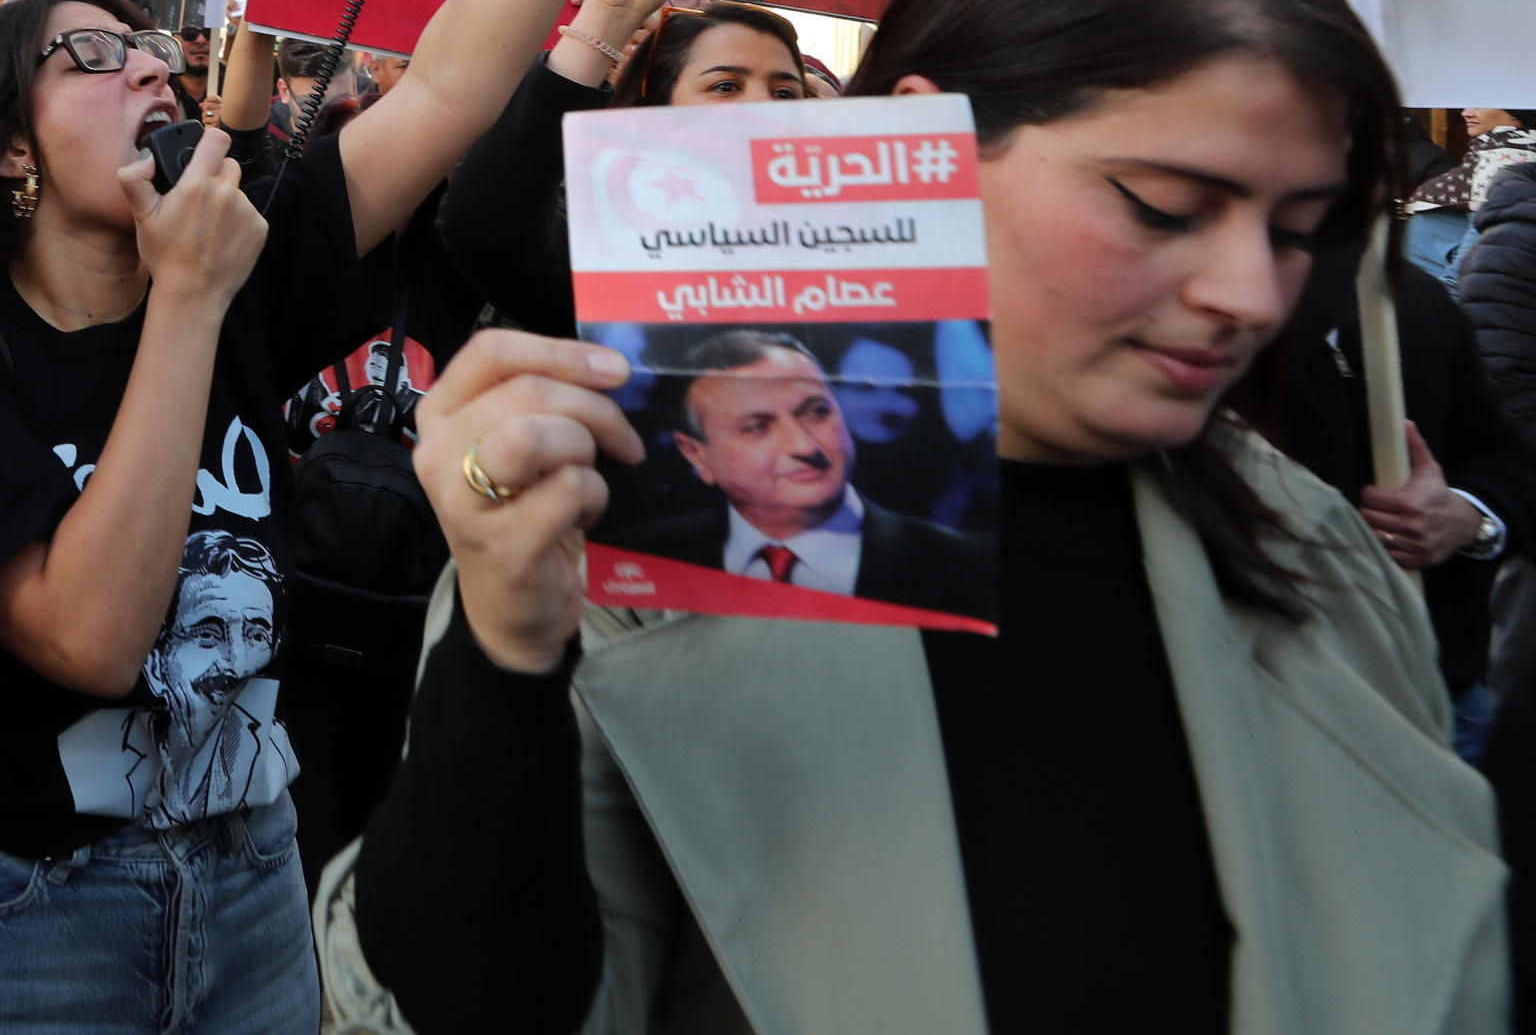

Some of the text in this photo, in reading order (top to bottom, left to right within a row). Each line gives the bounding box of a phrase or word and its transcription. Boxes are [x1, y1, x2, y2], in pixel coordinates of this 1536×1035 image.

[640, 218, 917, 259] للسجين السياسي
[656, 274, 897, 321] عصام الشابي
